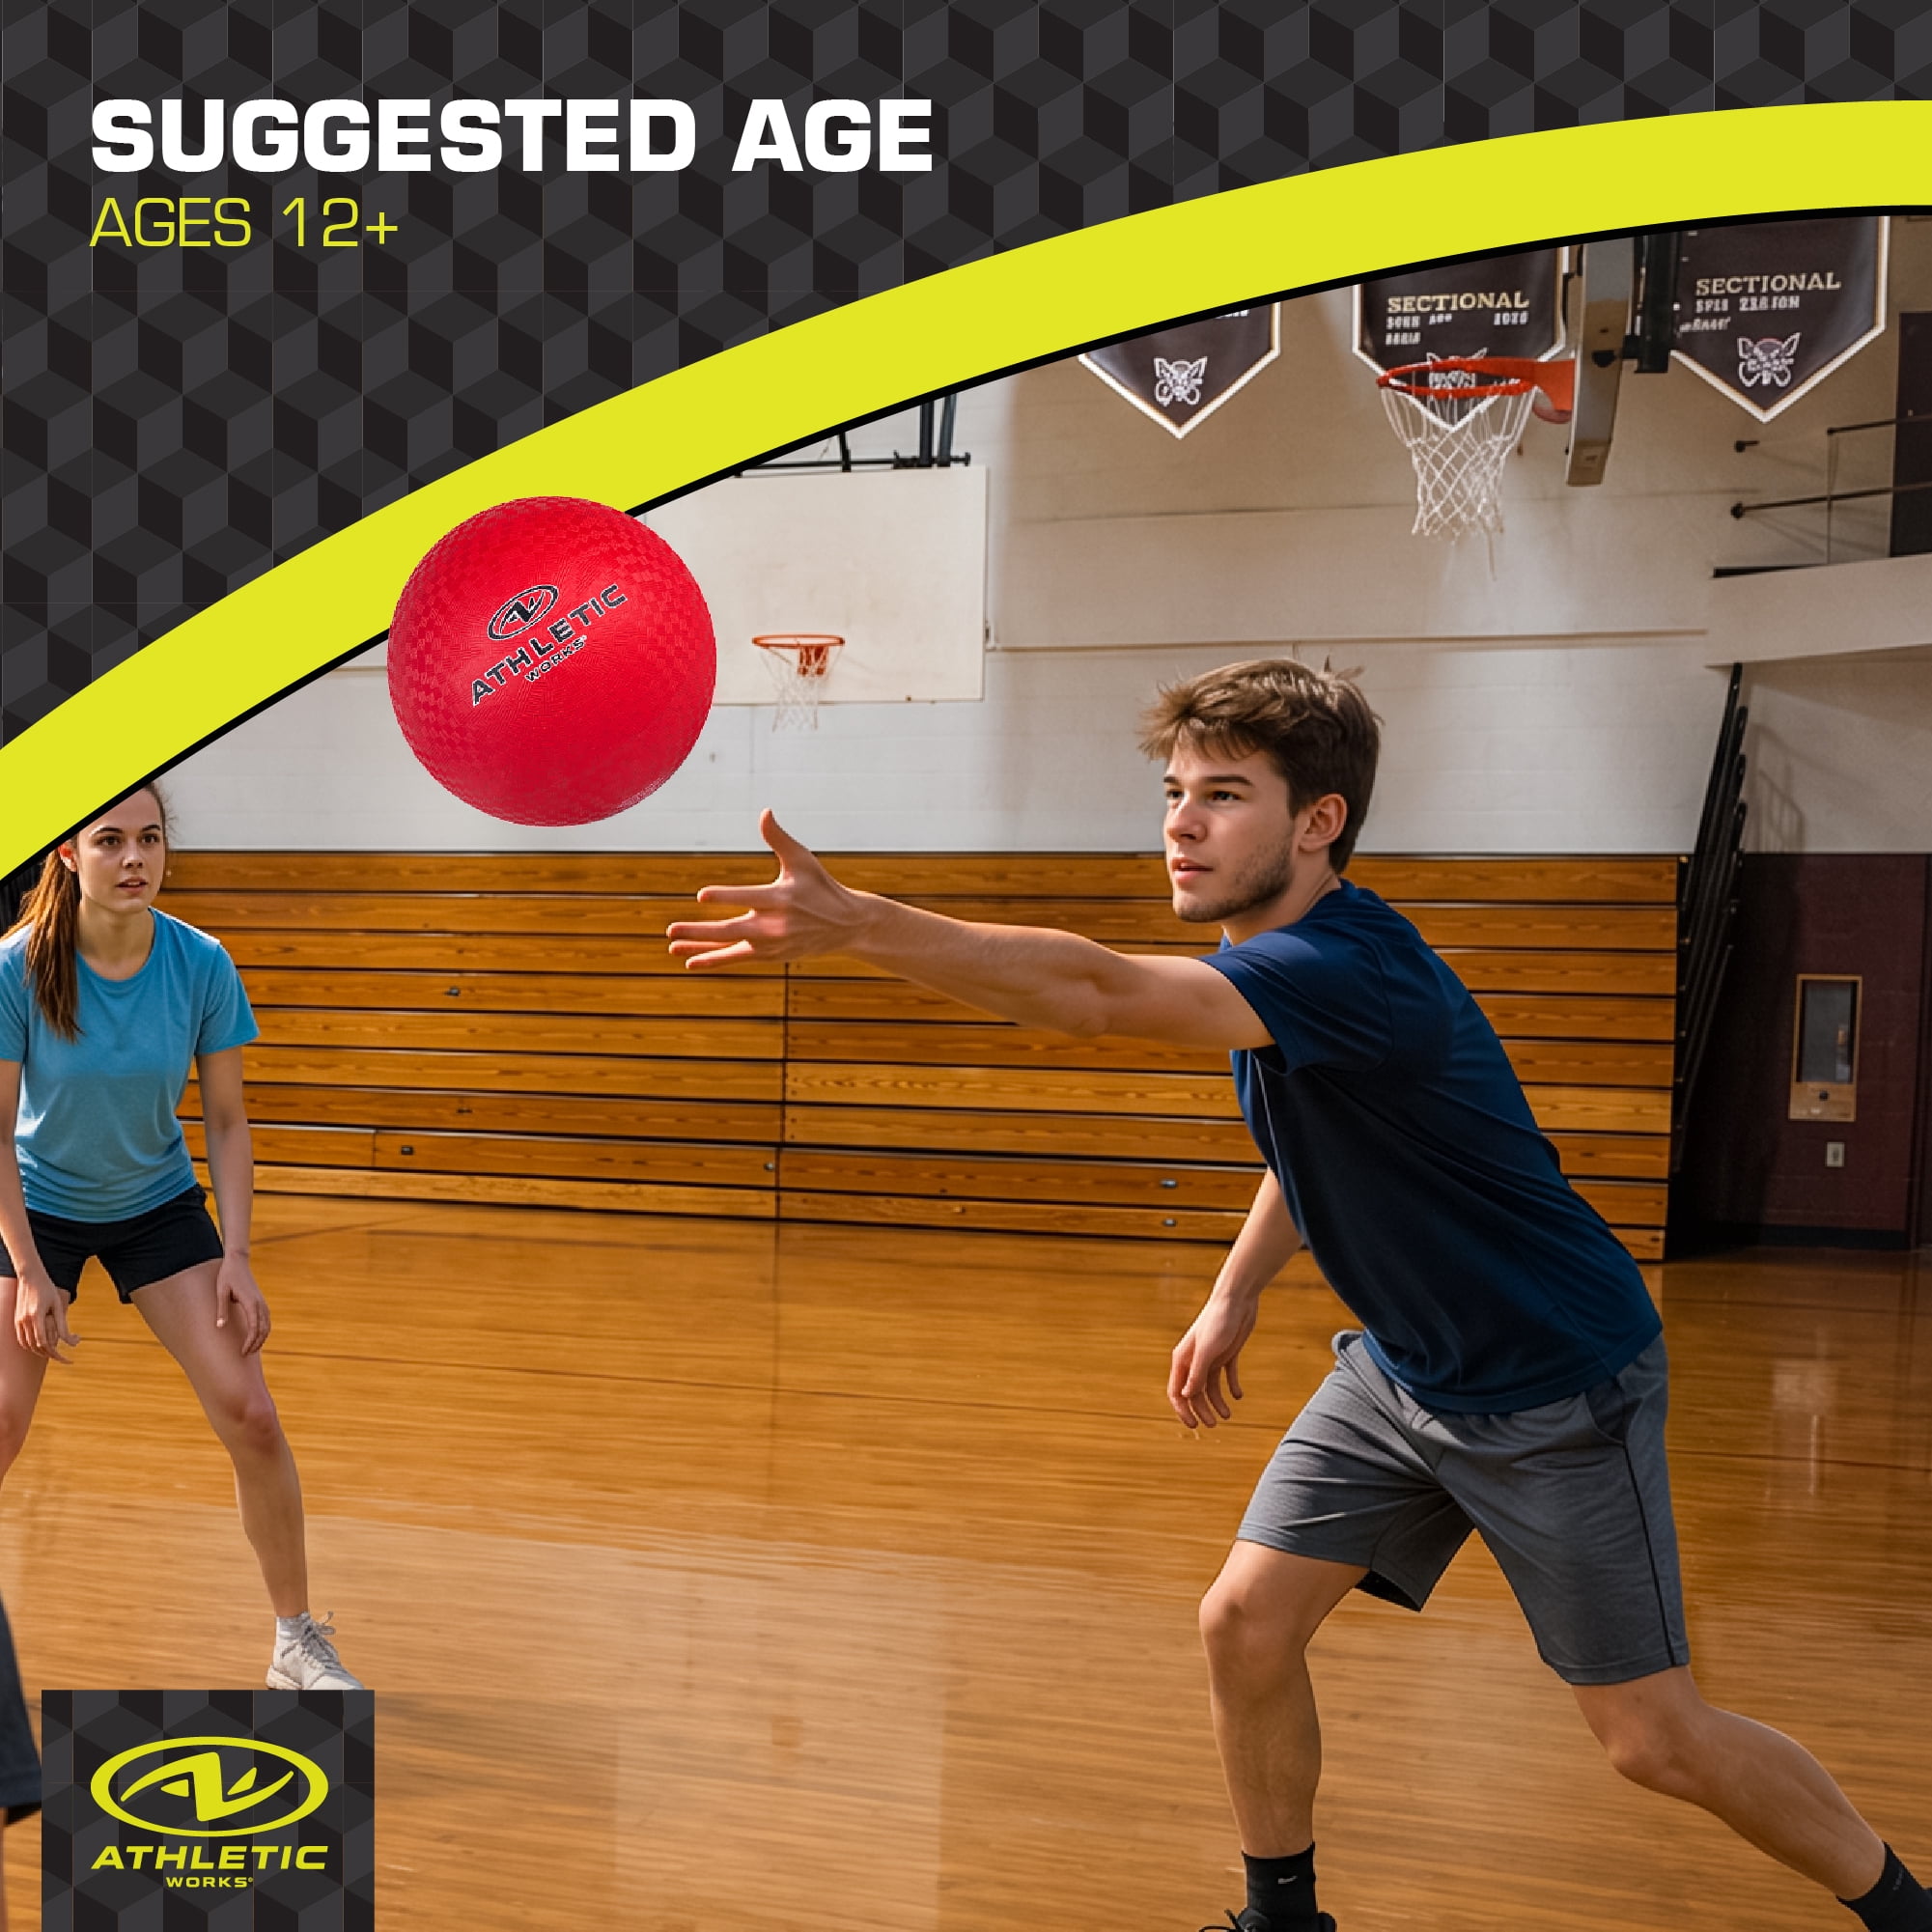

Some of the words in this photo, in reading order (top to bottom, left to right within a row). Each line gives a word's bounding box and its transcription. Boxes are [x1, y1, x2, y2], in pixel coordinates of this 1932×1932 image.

[1695, 270, 1842, 296] SECTIONAL
[1386, 291, 1530, 314] SECTIONAL
[471, 583, 628, 707] ATHLETIC
[524, 637, 585, 682] WORKS
